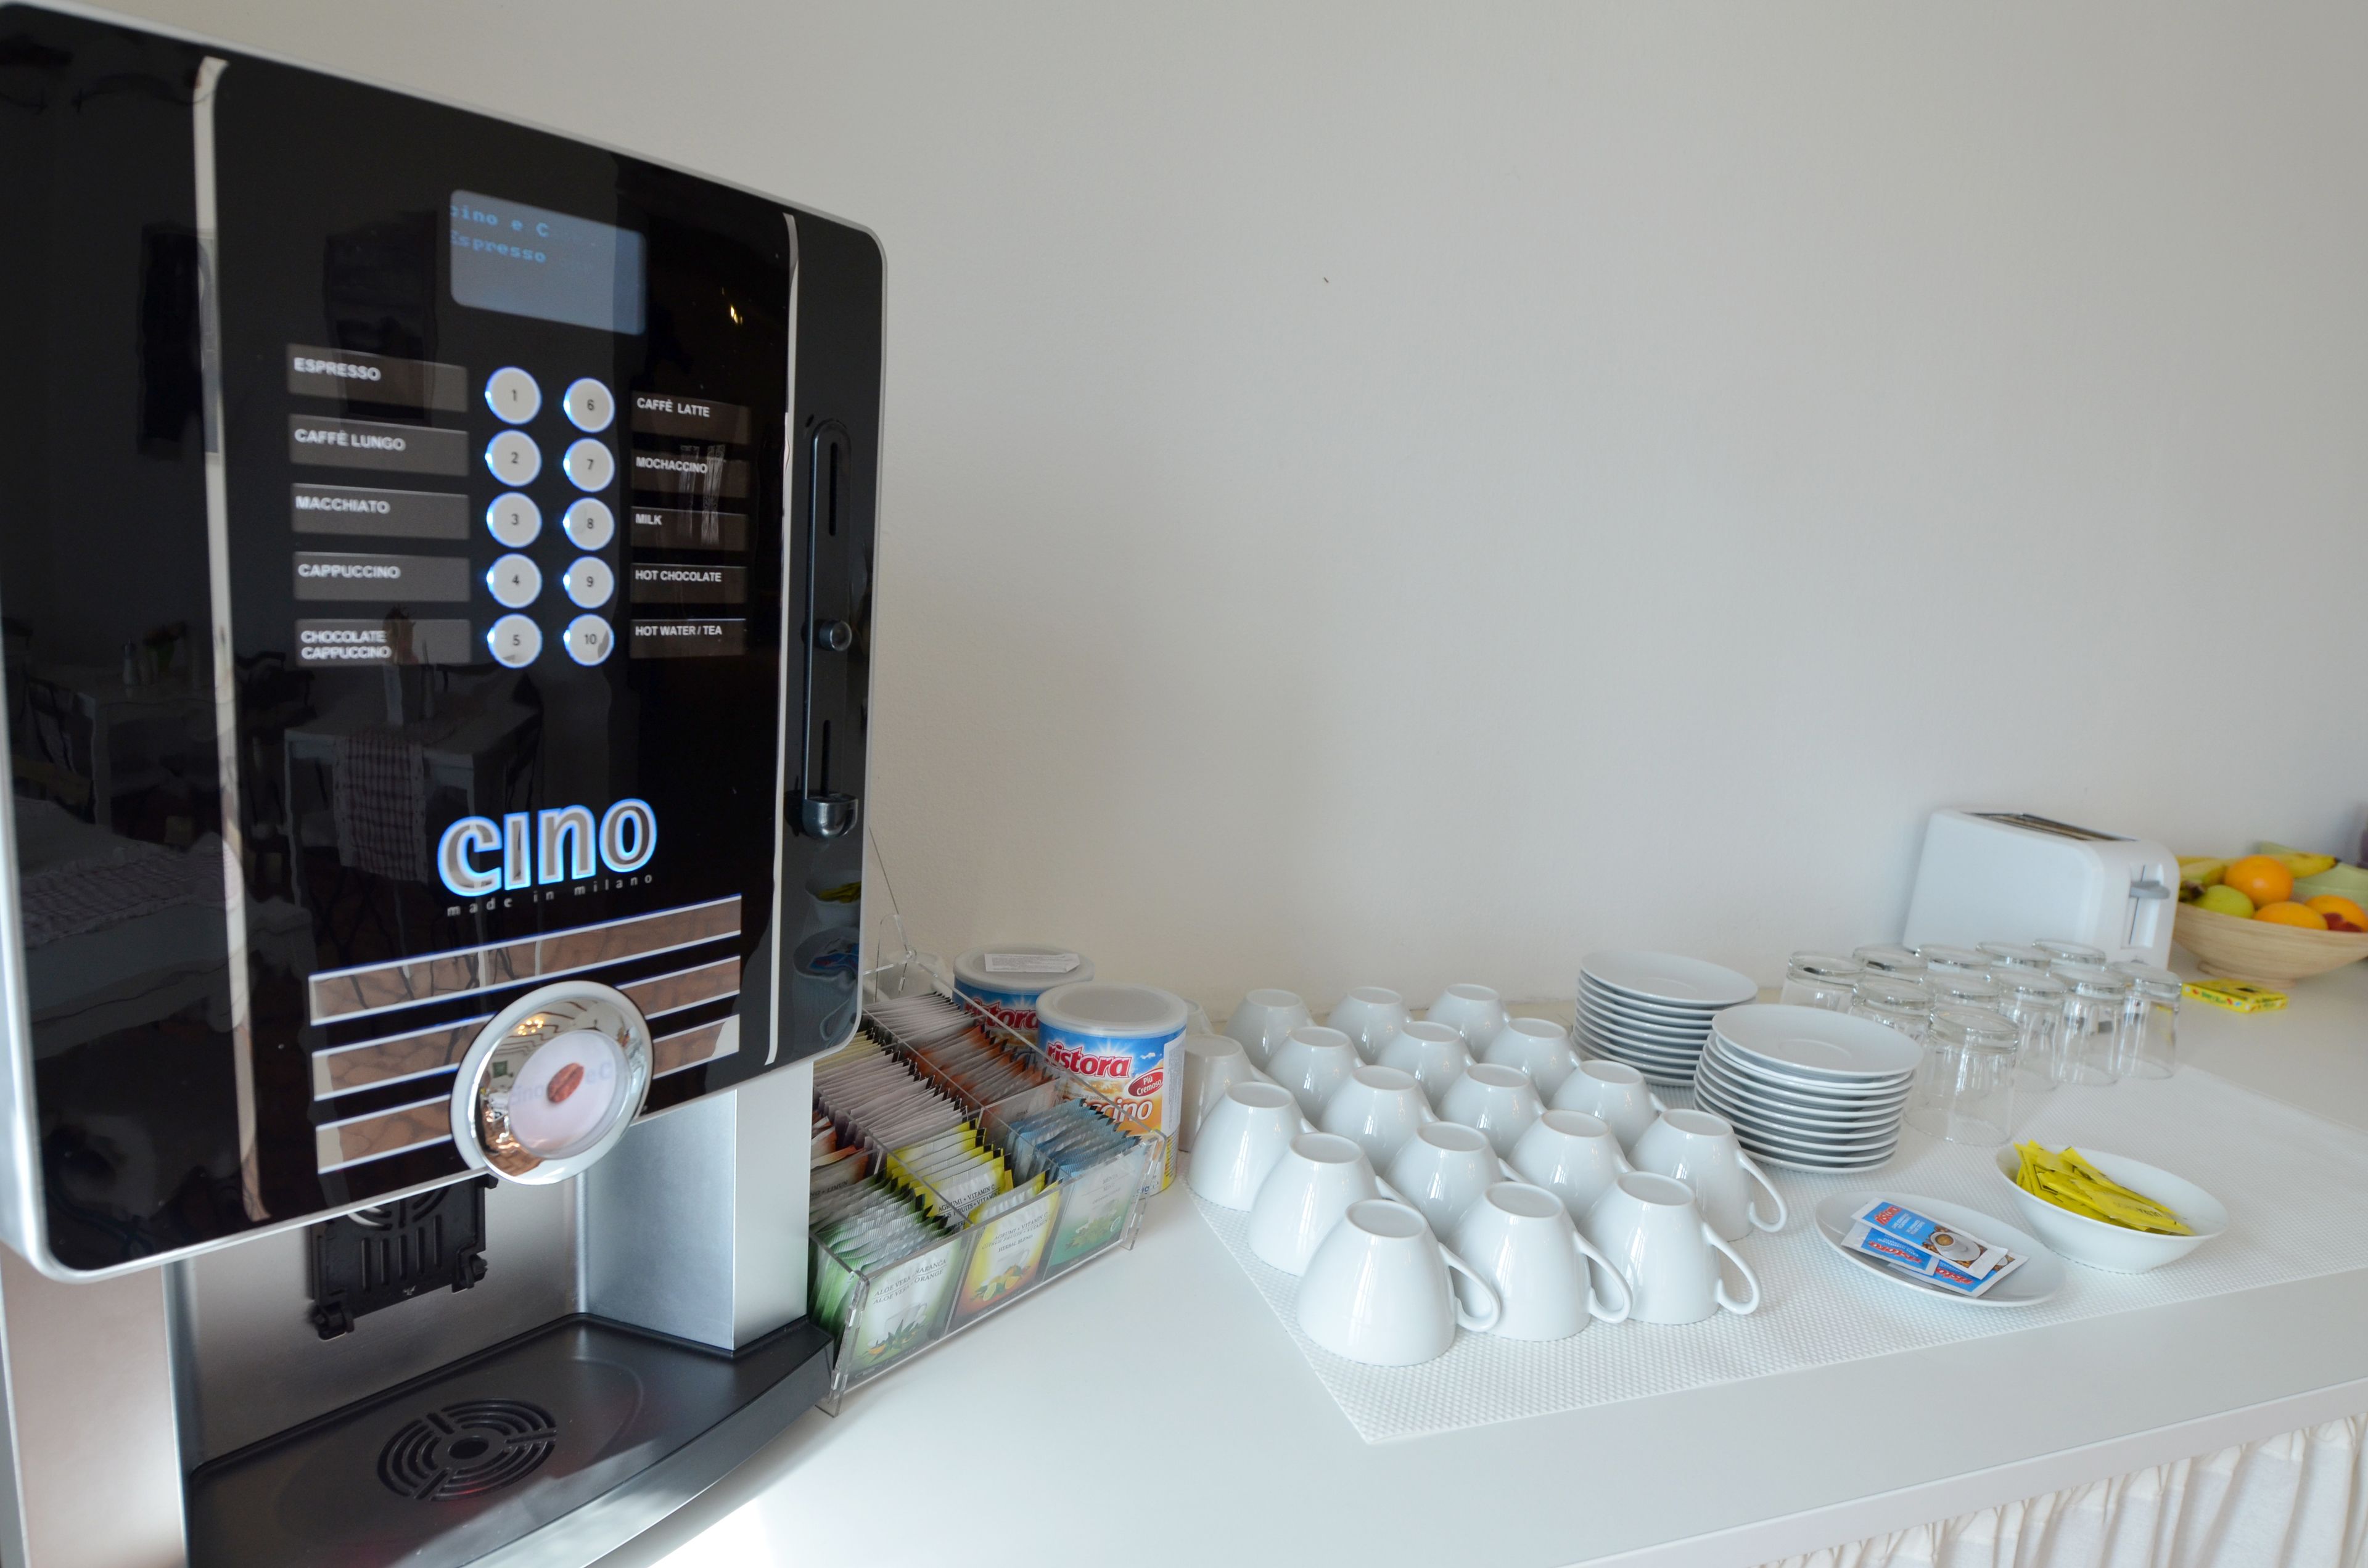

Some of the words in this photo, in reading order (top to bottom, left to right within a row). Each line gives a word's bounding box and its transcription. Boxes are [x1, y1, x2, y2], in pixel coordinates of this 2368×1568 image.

[511, 219, 523, 231] e
[536, 222, 549, 237] C
[294, 357, 381, 381] ESPRESSO
[512, 389, 517, 401] 1
[587, 399, 594, 411] 6
[637, 398, 673, 412] CAFFÈ
[678, 403, 710, 417] LATTE
[294, 429, 348, 446] CAFFÈ
[351, 434, 406, 451] LUNGO
[511, 451, 519, 464] 2
[587, 459, 594, 470] 7
[636, 457, 708, 474] MOCHACCINO
[295, 496, 390, 514] MACCHIATO
[511, 514, 519, 525] 3
[587, 518, 594, 529] 8
[635, 514, 662, 525] MILK
[298, 564, 401, 578] CAPPUCCINO
[635, 570, 658, 580] HOT
[660, 571, 722, 582] CHOCOLATE
[512, 574, 520, 586] 4
[586, 576, 594, 587] 9
[301, 631, 387, 643] CHOCOLATE
[635, 626, 658, 636] HOT
[660, 626, 696, 636] WATER
[703, 625, 722, 635] TEA
[513, 634, 520, 646] 5
[585, 634, 597, 644] 10
[301, 646, 392, 659] CAPPUCCINO
[437, 798, 657, 897] cino
[447, 897, 512, 917] made
[533, 891, 554, 902] in
[574, 874, 652, 895] milano
[1143, 1076, 1153, 1085] Più
[1137, 1079, 1162, 1096] Cremoso
[968, 1186, 990, 1200] VITAMIN
[873, 1295, 894, 1304] ALOE
[914, 1269, 944, 1283] ORANGE
[874, 1285, 893, 1296] ALOE
[895, 1276, 911, 1288] VERA
